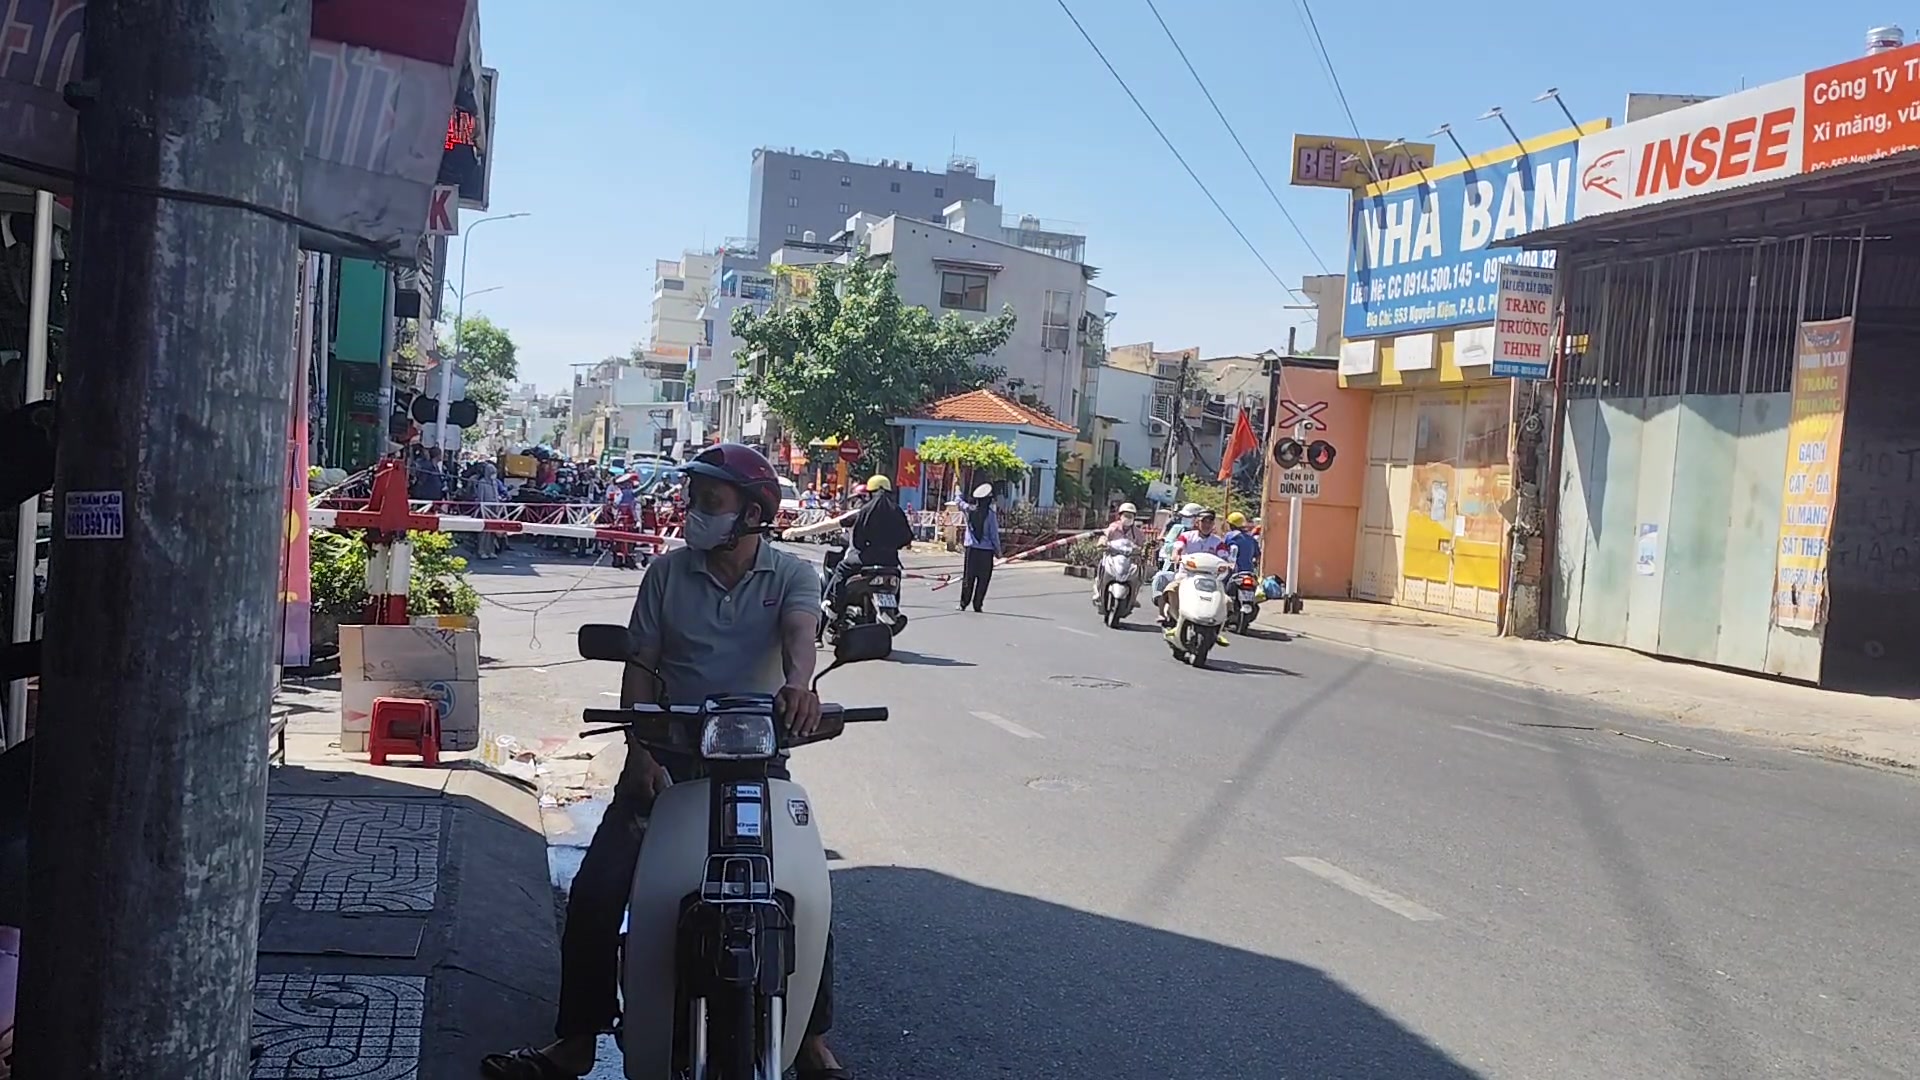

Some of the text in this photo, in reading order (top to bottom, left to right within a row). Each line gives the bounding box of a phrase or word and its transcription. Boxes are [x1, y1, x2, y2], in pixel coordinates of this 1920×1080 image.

[1813, 58, 1920, 105] Công Ty T
[1812, 122, 1831, 143] Xi
[1835, 113, 1892, 139] măng,
[1298, 140, 1352, 183] BẾP
[1635, 107, 1796, 198] INSEE
[1354, 158, 1571, 272] NHÀ BÁN
[1387, 274, 1401, 300] CC
[1404, 261, 1473, 297] 0914.500.145
[1394, 306, 1408, 324] 553
[1505, 297, 1546, 315] TRANG
[1499, 317, 1549, 337] TRƯỜNG
[1503, 340, 1541, 359] THỊNH
[1280, 480, 1303, 494] DỪNG
